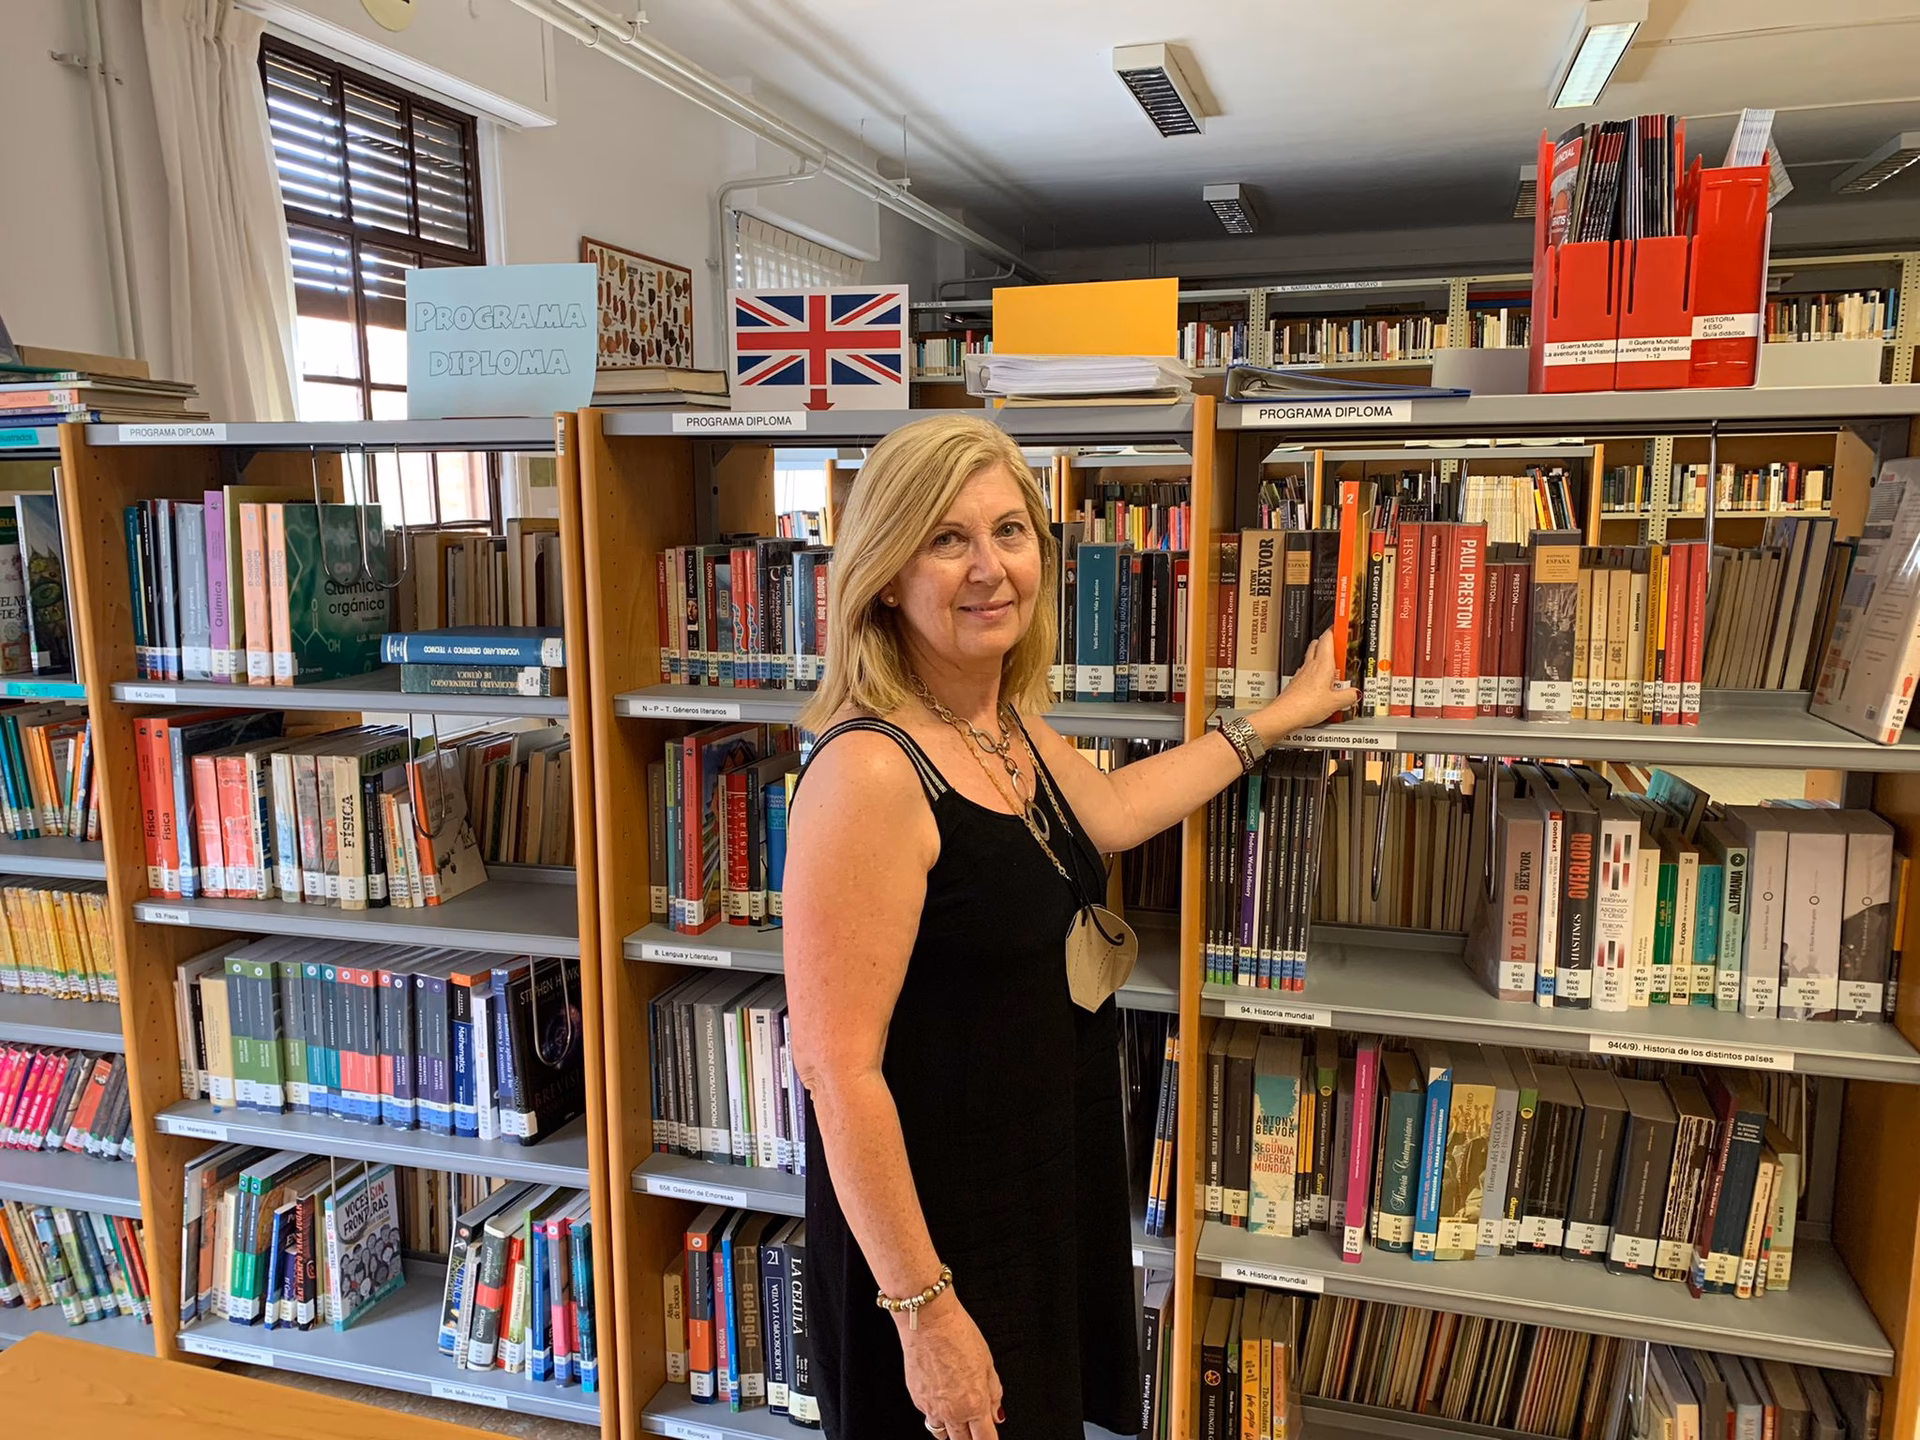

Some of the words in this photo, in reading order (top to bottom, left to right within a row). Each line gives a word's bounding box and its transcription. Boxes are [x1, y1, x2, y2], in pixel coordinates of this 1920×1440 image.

[415, 302, 587, 333] PROGRAMA
[429, 348, 571, 377] DIPLOMA
[686, 415, 743, 427] PROGRAMA
[746, 414, 793, 426] DIPLOMA
[1260, 408, 1333, 421] PROGRAMA
[1335, 405, 1395, 419] DIPLOMA
[130, 428, 175, 437] PROGRAMA
[178, 427, 215, 437] DIPLOMA
[1402, 538, 1413, 574] NASH
[1459, 539, 1477, 570] PAUL
[1257, 538, 1274, 597] BEEVOR
[1489, 572, 1497, 602] PRESTON
[1512, 573, 1520, 604] PRESTON
[214, 578, 224, 628] Química
[329, 597, 385, 617] orgánica
[1400, 598, 1410, 619] Rojas
[1456, 572, 1475, 629] PRESTON
[672, 704, 699, 714] Géneros
[700, 706, 727, 716] literarios
[1303, 733, 1316, 743] los
[1317, 734, 1350, 744] distintos
[1352, 735, 1379, 747] países
[146, 809, 156, 838] Física
[161, 812, 171, 841] Física
[340, 794, 355, 849] FÍSICA
[1519, 851, 1531, 891] BEEVOR
[1569, 832, 1591, 899] OVERLORD
[1512, 894, 1528, 905] D
[1508, 911, 1527, 938] DÍA
[1510, 943, 1526, 960] EL
[1240, 1005, 1251, 1014] 94.
[1254, 1007, 1282, 1019] Historia
[1284, 1009, 1314, 1021] mundial
[707, 1019, 715, 1064] INDUSTRIAL
[1607, 1041, 1641, 1052] 94(4/9).
[1643, 1044, 1676, 1056] Historia
[1678, 1046, 1689, 1056] de
[1691, 1047, 1703, 1058] los
[1705, 1049, 1742, 1061] distintos
[1744, 1051, 1775, 1064] países
[709, 1065, 718, 1127] PRODUCTIVIDAD
[1255, 1124, 1295, 1139] BEEVOR
[1257, 1114, 1295, 1127] ANTONY
[1254, 1142, 1295, 1156] SEGUNDA
[1256, 1153, 1291, 1165] GUERRA
[1253, 1162, 1293, 1175] MUNDIAL
[766, 1250, 780, 1266] 21
[791, 1257, 802, 1277] LA
[1236, 1268, 1248, 1278] 94.
[1250, 1270, 1277, 1282] Historia
[1279, 1274, 1307, 1286] mundial
[791, 1280, 803, 1335] CELULA
